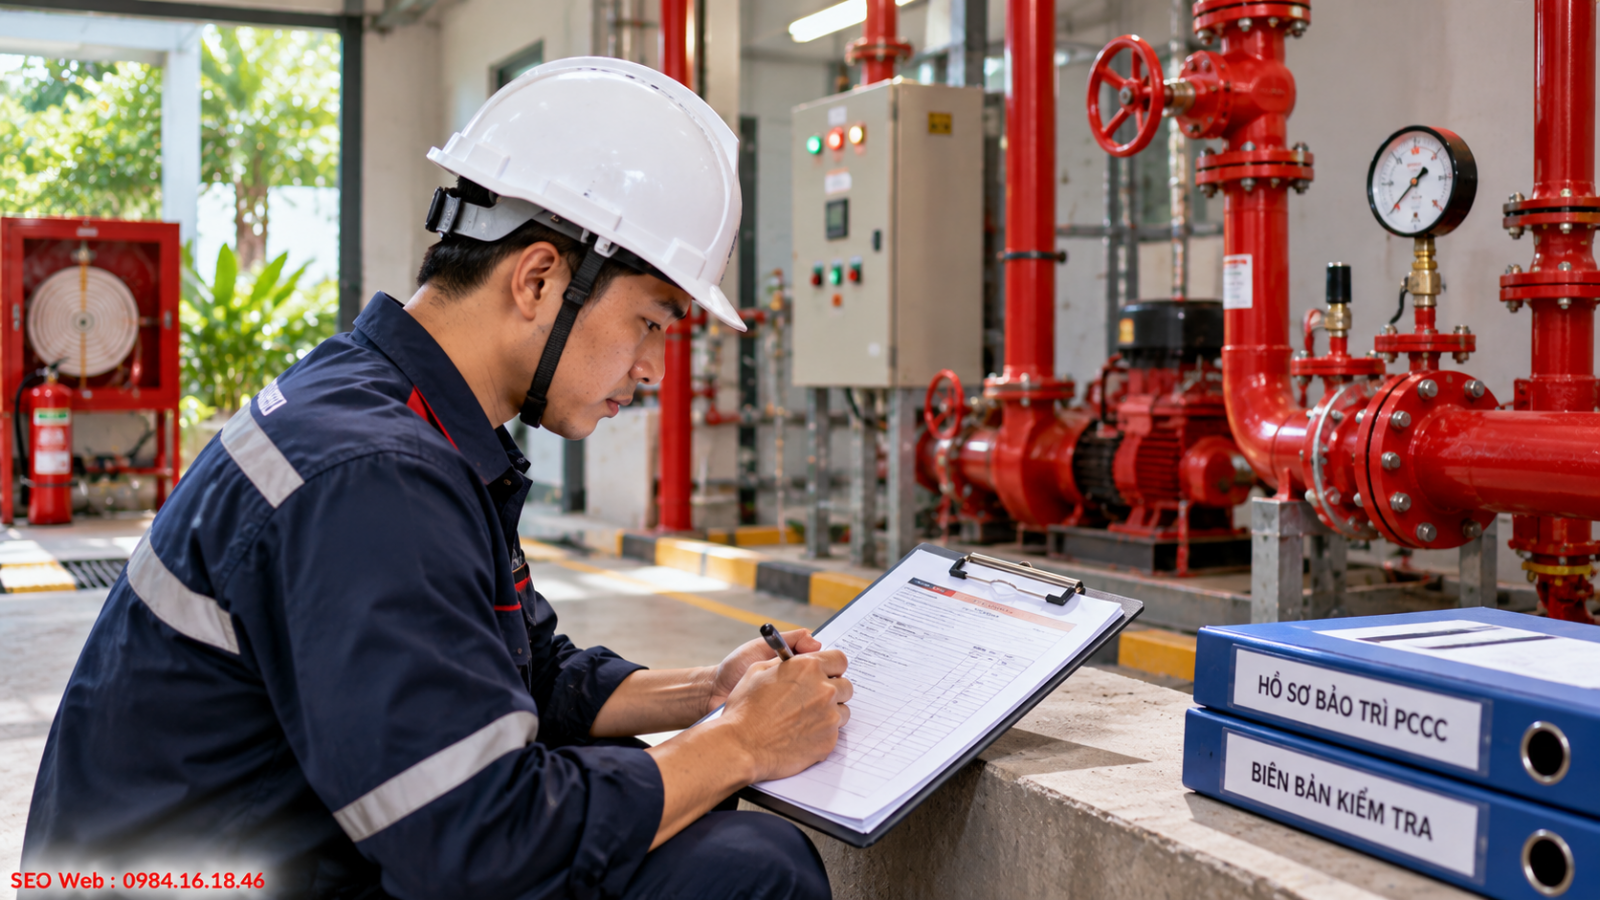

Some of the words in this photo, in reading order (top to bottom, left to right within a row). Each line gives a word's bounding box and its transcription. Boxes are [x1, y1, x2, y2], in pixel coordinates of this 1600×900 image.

[1287, 683, 1311, 706] SƠ
[1316, 685, 1353, 717] BẢO
[1360, 698, 1388, 727] TRÌ
[1394, 708, 1448, 742] PCCC
[1252, 761, 1289, 793] BIÊN
[1337, 786, 1385, 825] KIỂM
[1391, 807, 1433, 841] TRA
